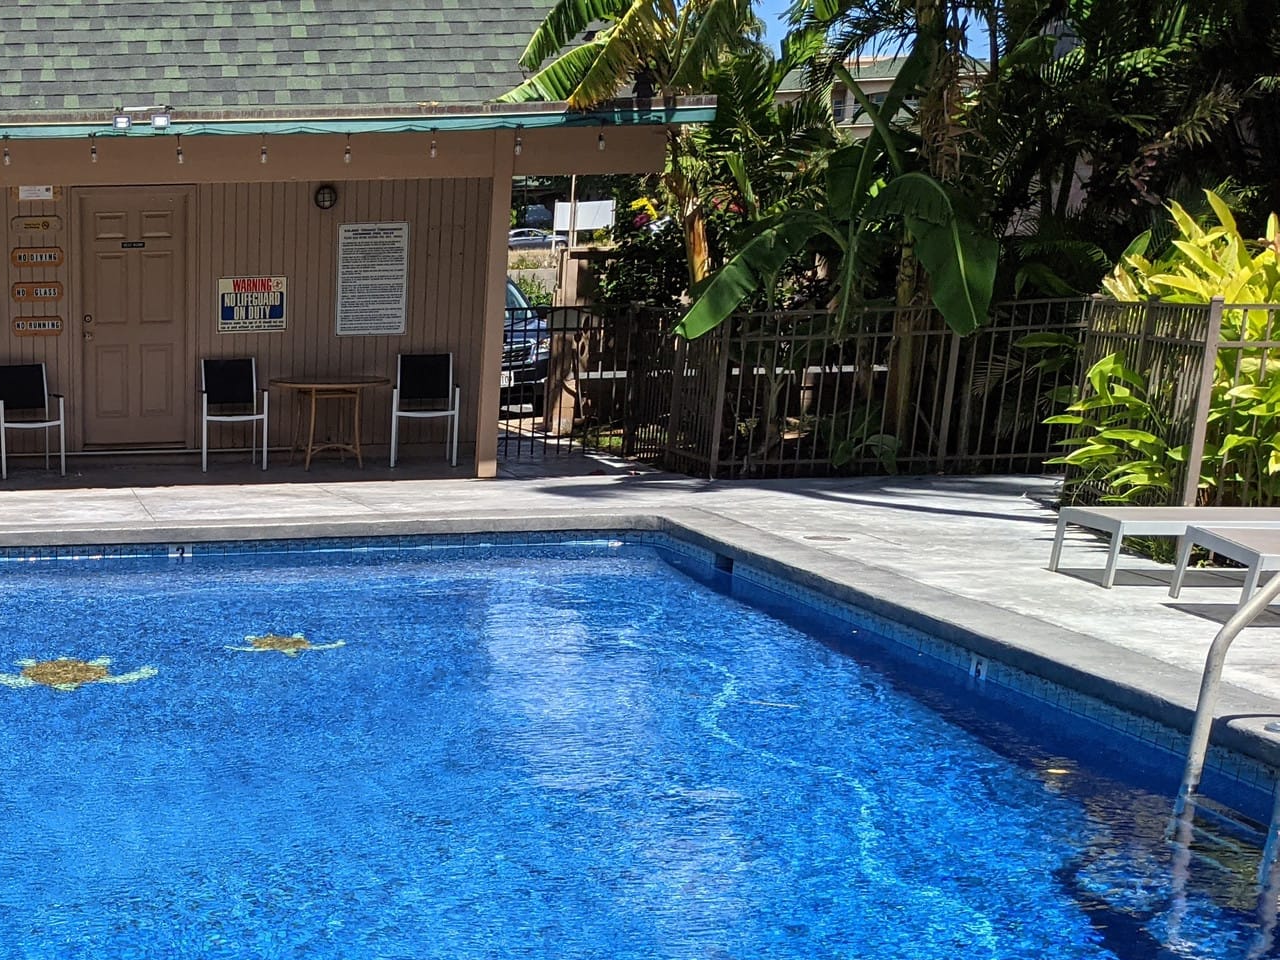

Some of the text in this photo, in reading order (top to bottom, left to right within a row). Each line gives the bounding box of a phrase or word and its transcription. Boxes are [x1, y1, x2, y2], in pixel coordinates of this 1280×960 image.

[30, 253, 57, 261] DIVING
[232, 278, 272, 293] WARNING
[16, 288, 57, 296] NO GLASS
[224, 292, 281, 307] NO LIFEGUARD
[233, 305, 271, 320] ON DUTY
[28, 321, 60, 329] RUNNING
